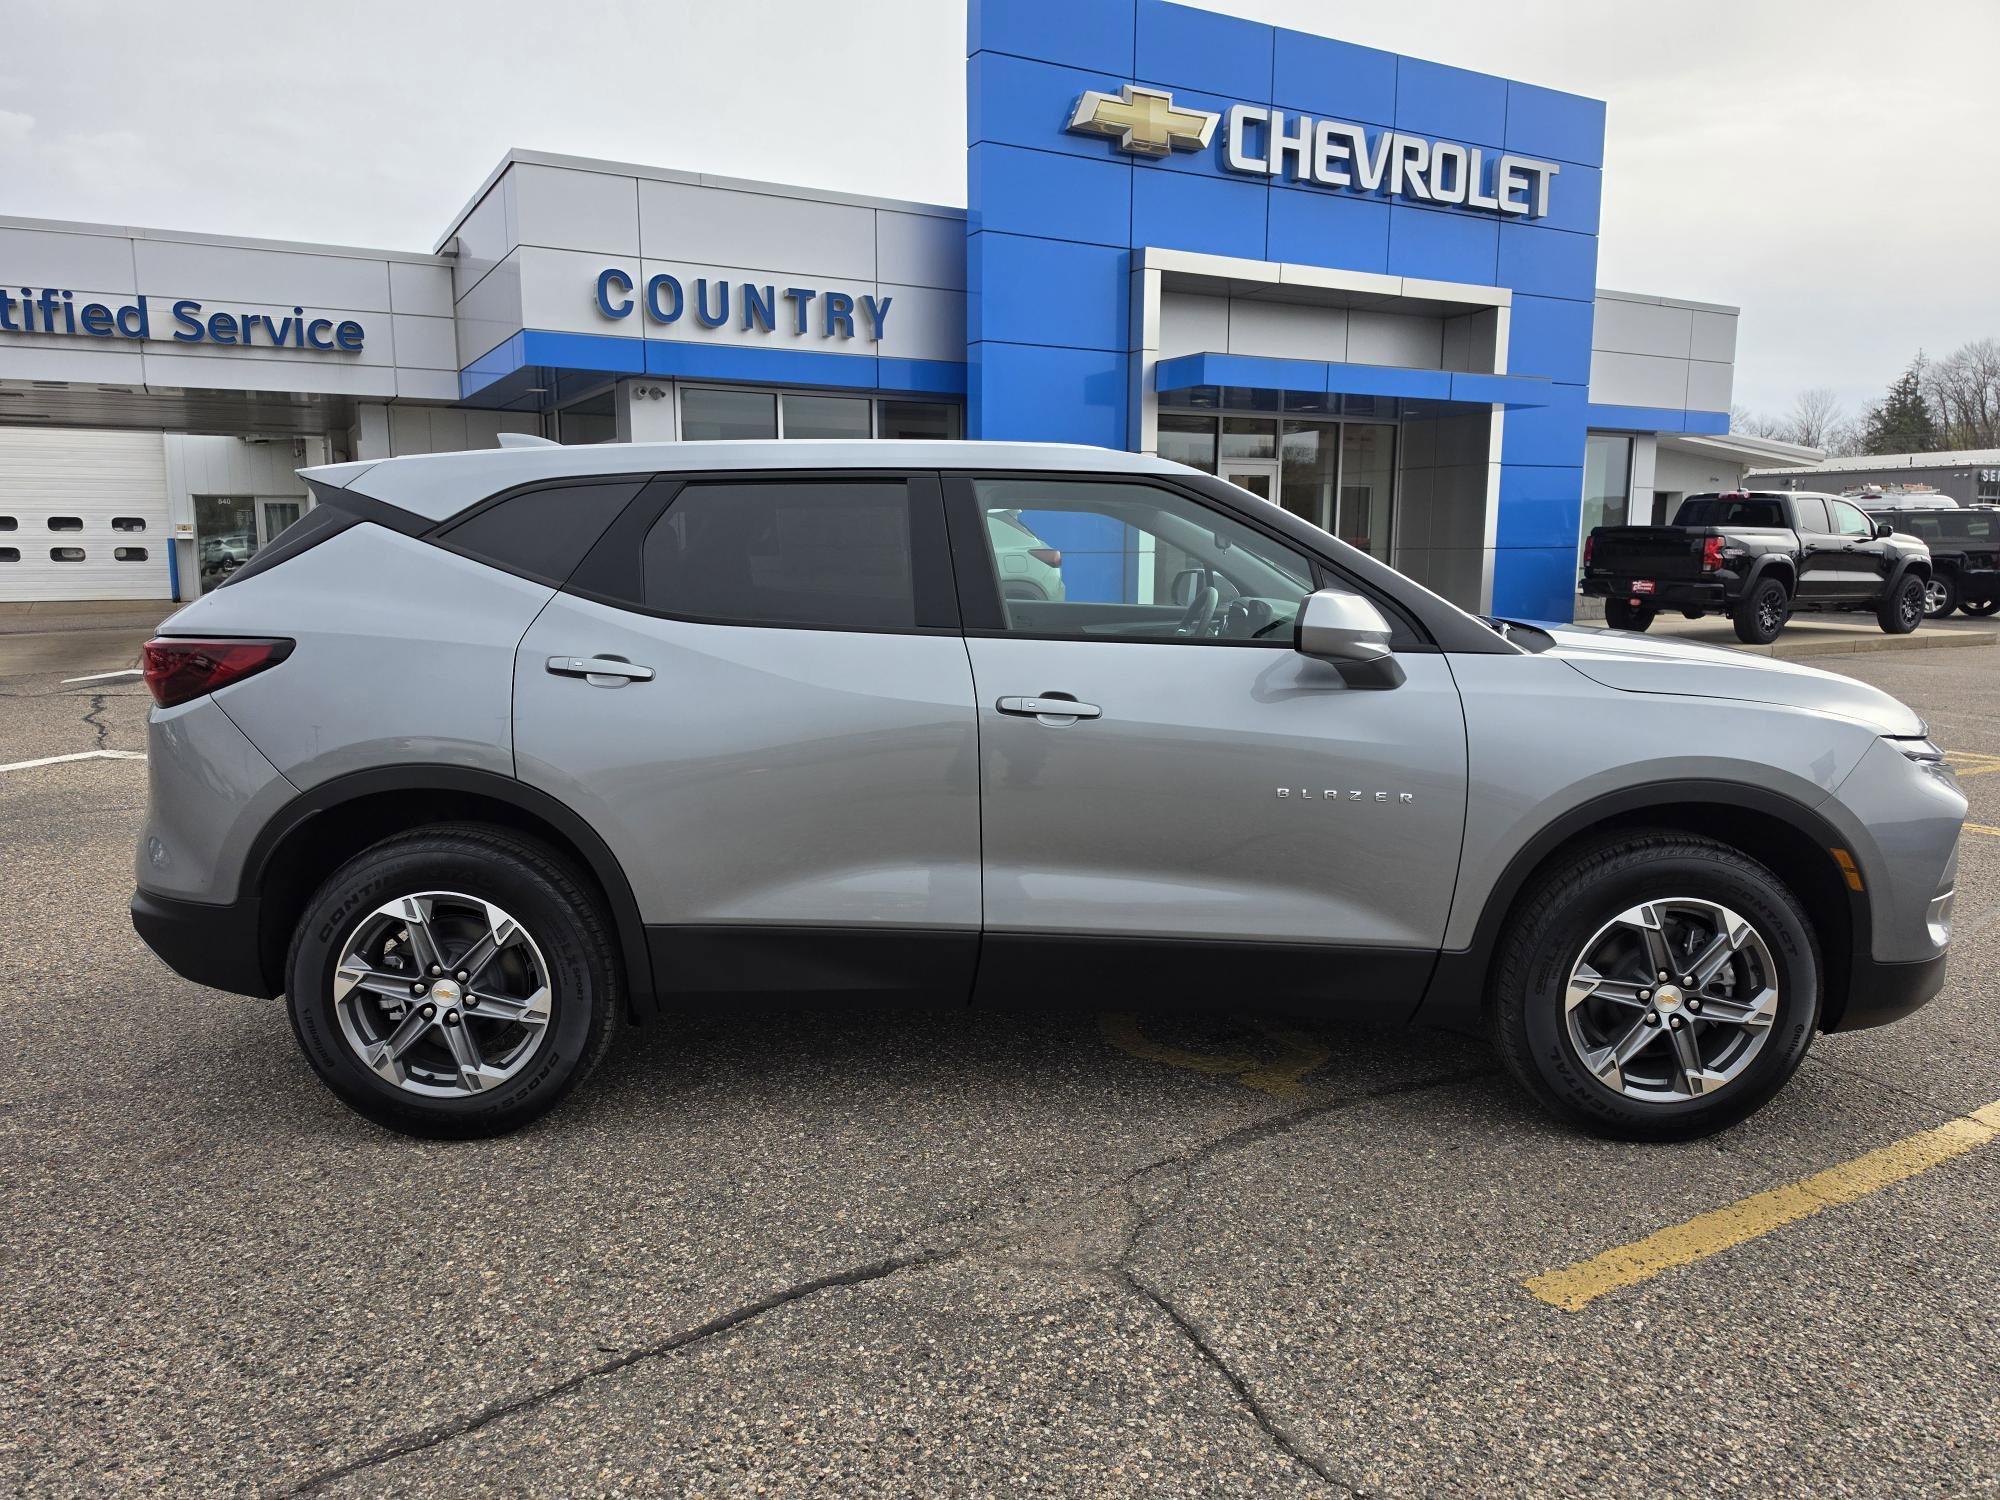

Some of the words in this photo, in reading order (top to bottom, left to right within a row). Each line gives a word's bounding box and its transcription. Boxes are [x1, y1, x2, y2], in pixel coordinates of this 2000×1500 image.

[1224, 104, 1560, 220] CHEVROLET
[0, 286, 150, 341] tified
[173, 300, 364, 352] Service
[596, 268, 893, 341] COUNTRY
[1276, 788, 1414, 804] BLAZER
